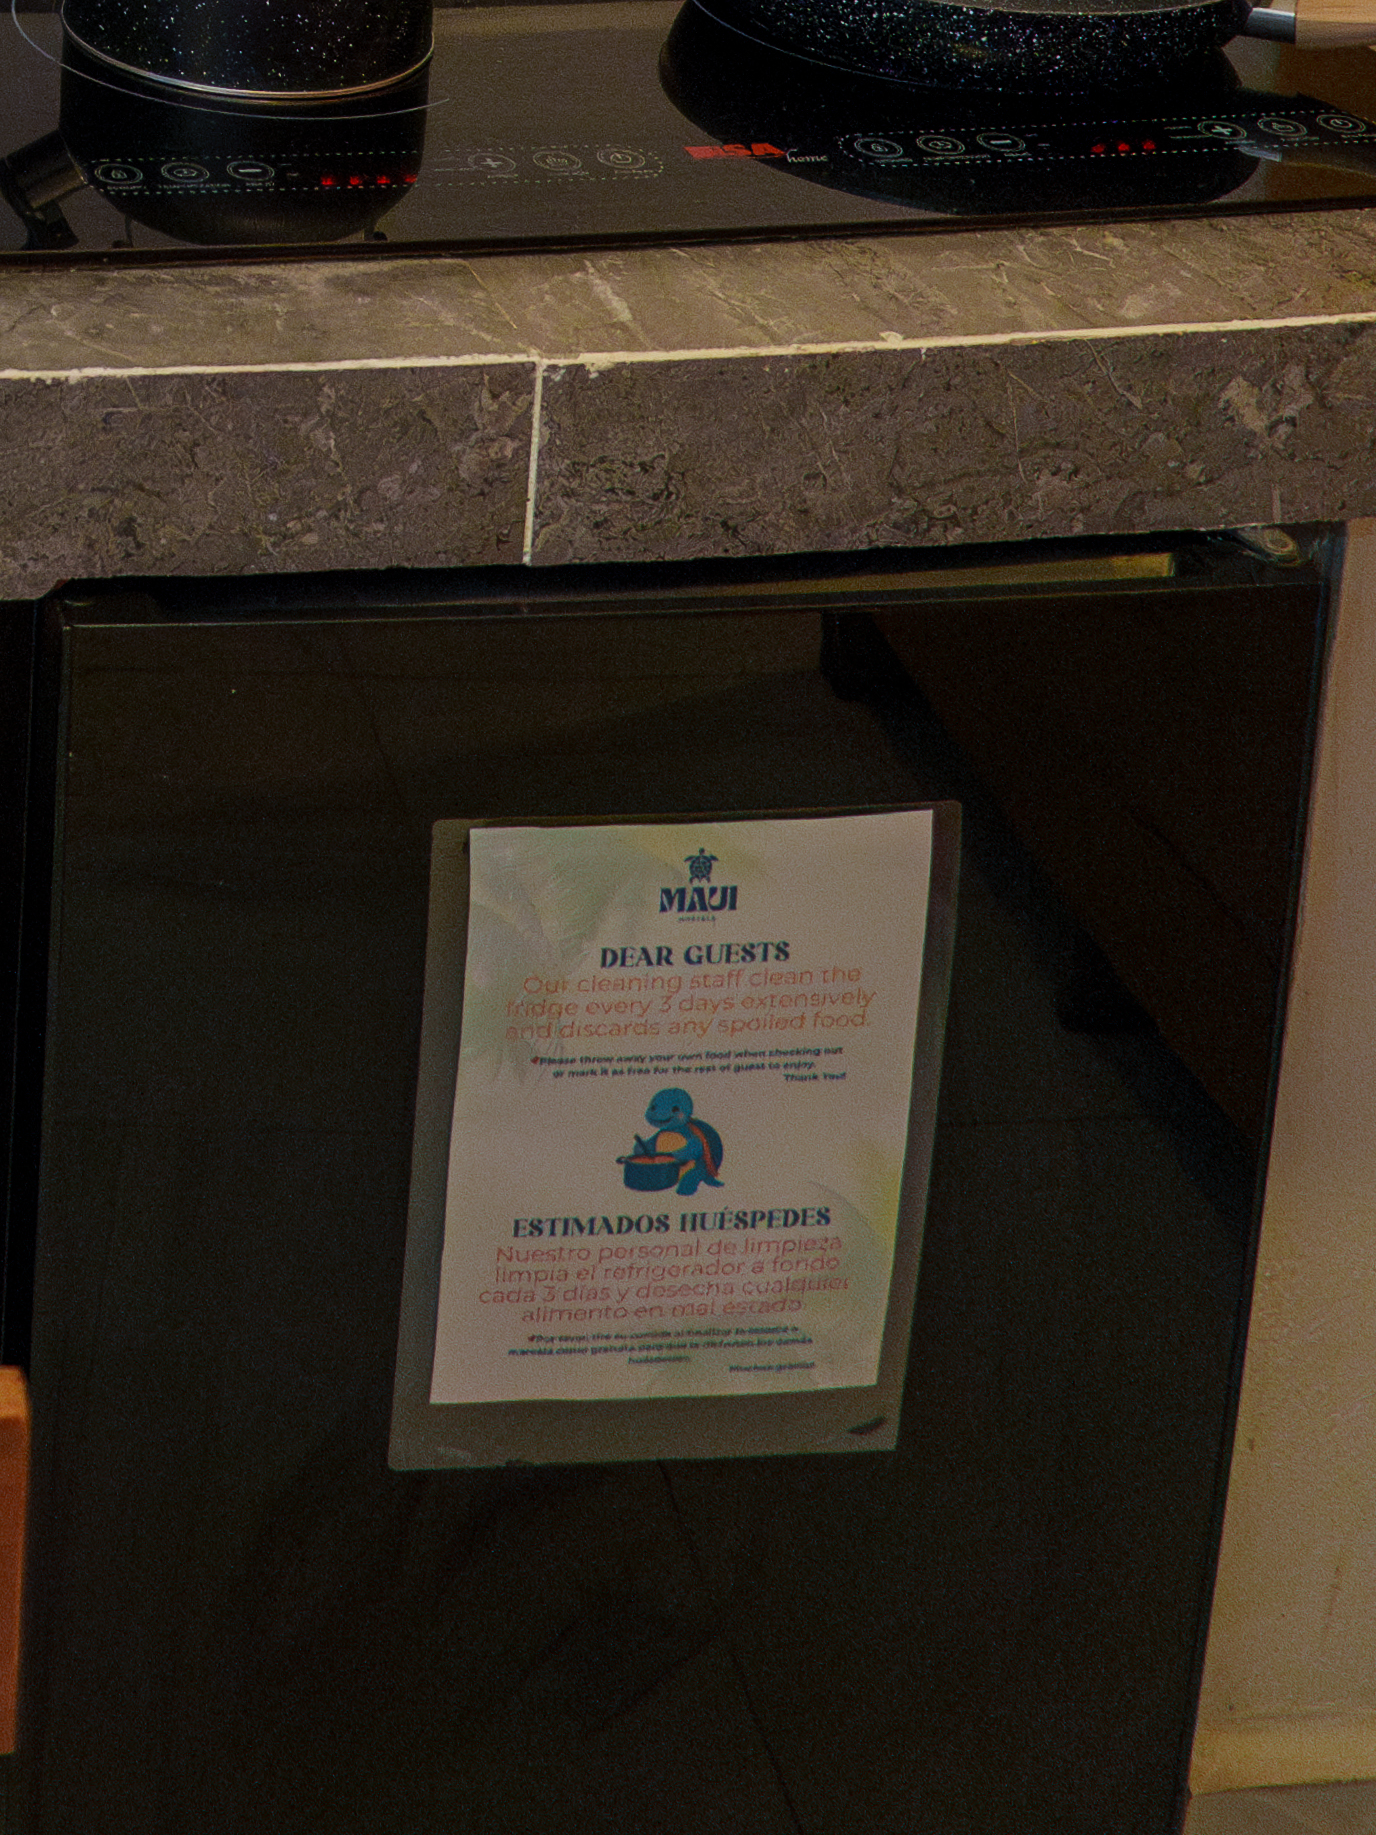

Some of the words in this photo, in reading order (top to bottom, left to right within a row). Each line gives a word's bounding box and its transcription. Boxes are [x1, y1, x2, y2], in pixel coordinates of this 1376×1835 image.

[786, 148, 830, 163] home
[659, 884, 737, 913] MAUI
[600, 946, 674, 968] DEAR
[683, 941, 790, 965] GUESTS
[523, 975, 568, 994] Our
[577, 975, 682, 994] cleaning
[690, 968, 746, 990] staff
[749, 968, 813, 987] clean
[823, 966, 862, 983] the
[507, 998, 578, 1018] fridge
[586, 1001, 653, 1018] every
[660, 995, 673, 1013] 3
[679, 995, 735, 1014] days
[741, 987, 877, 1009] extensively
[505, 1022, 551, 1040] and
[559, 1019, 660, 1039] discards
[668, 1018, 714, 1038] any
[718, 1012, 807, 1038] spoiled
[513, 1213, 670, 1238] ESTIMADOS
[679, 1205, 831, 1233] HUÉSPEDES
[496, 1246, 591, 1263] Nuestro
[599, 1237, 700, 1264] personal
[707, 1239, 737, 1255] de
[744, 1236, 842, 1256] limpieza
[495, 1265, 568, 1287] limpia
[576, 1265, 595, 1281] el
[604, 1259, 747, 1282] refrigerador
[751, 1261, 764, 1274] a
[772, 1256, 840, 1272] fondo
[479, 1288, 536, 1304] cada
[542, 1285, 556, 1303] 3
[563, 1285, 611, 1302] días
[616, 1286, 629, 1304] y
[635, 1281, 734, 1299] desecha
[742, 1277, 849, 1295] cualquier
[522, 1306, 628, 1323] alimento
[634, 1305, 663, 1319] en
[672, 1300, 715, 1317] mal
